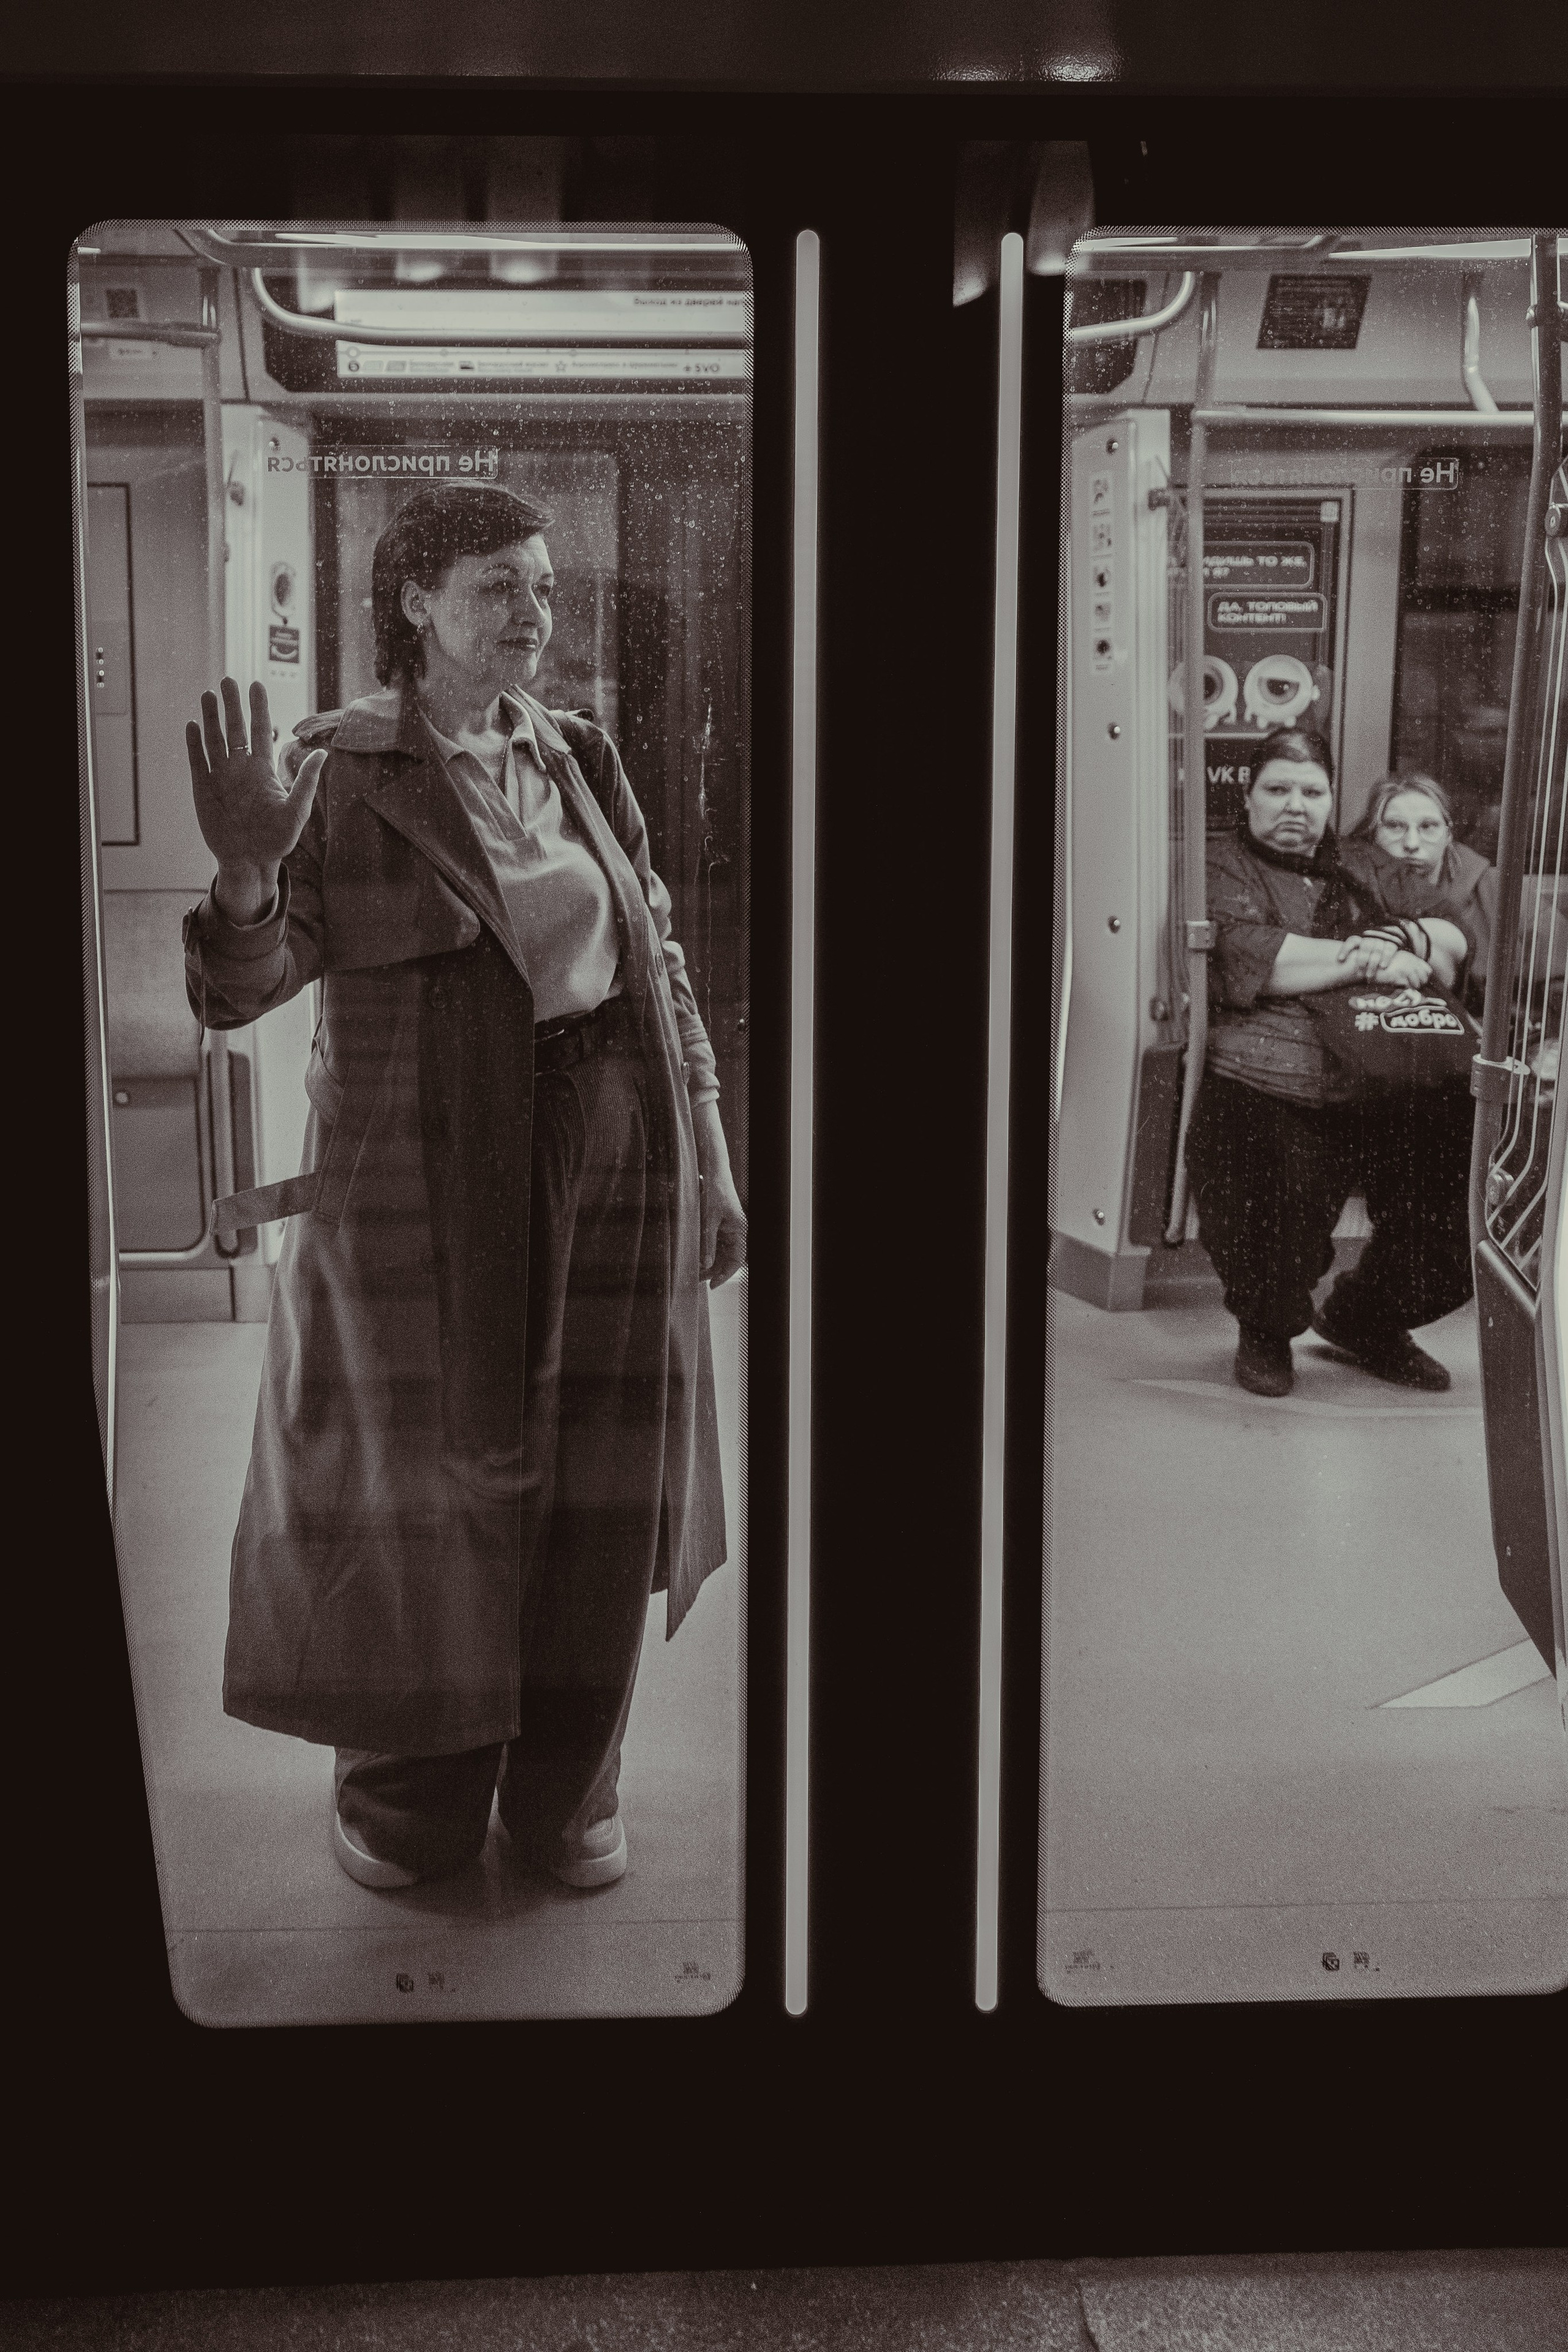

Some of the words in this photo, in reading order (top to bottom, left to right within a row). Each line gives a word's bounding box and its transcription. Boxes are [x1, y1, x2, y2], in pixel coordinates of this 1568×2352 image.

[1257, 556, 1278, 567] ТО
[1246, 600, 1318, 612] ТОПОВЫЙ
[1207, 766, 1234, 784] VK
